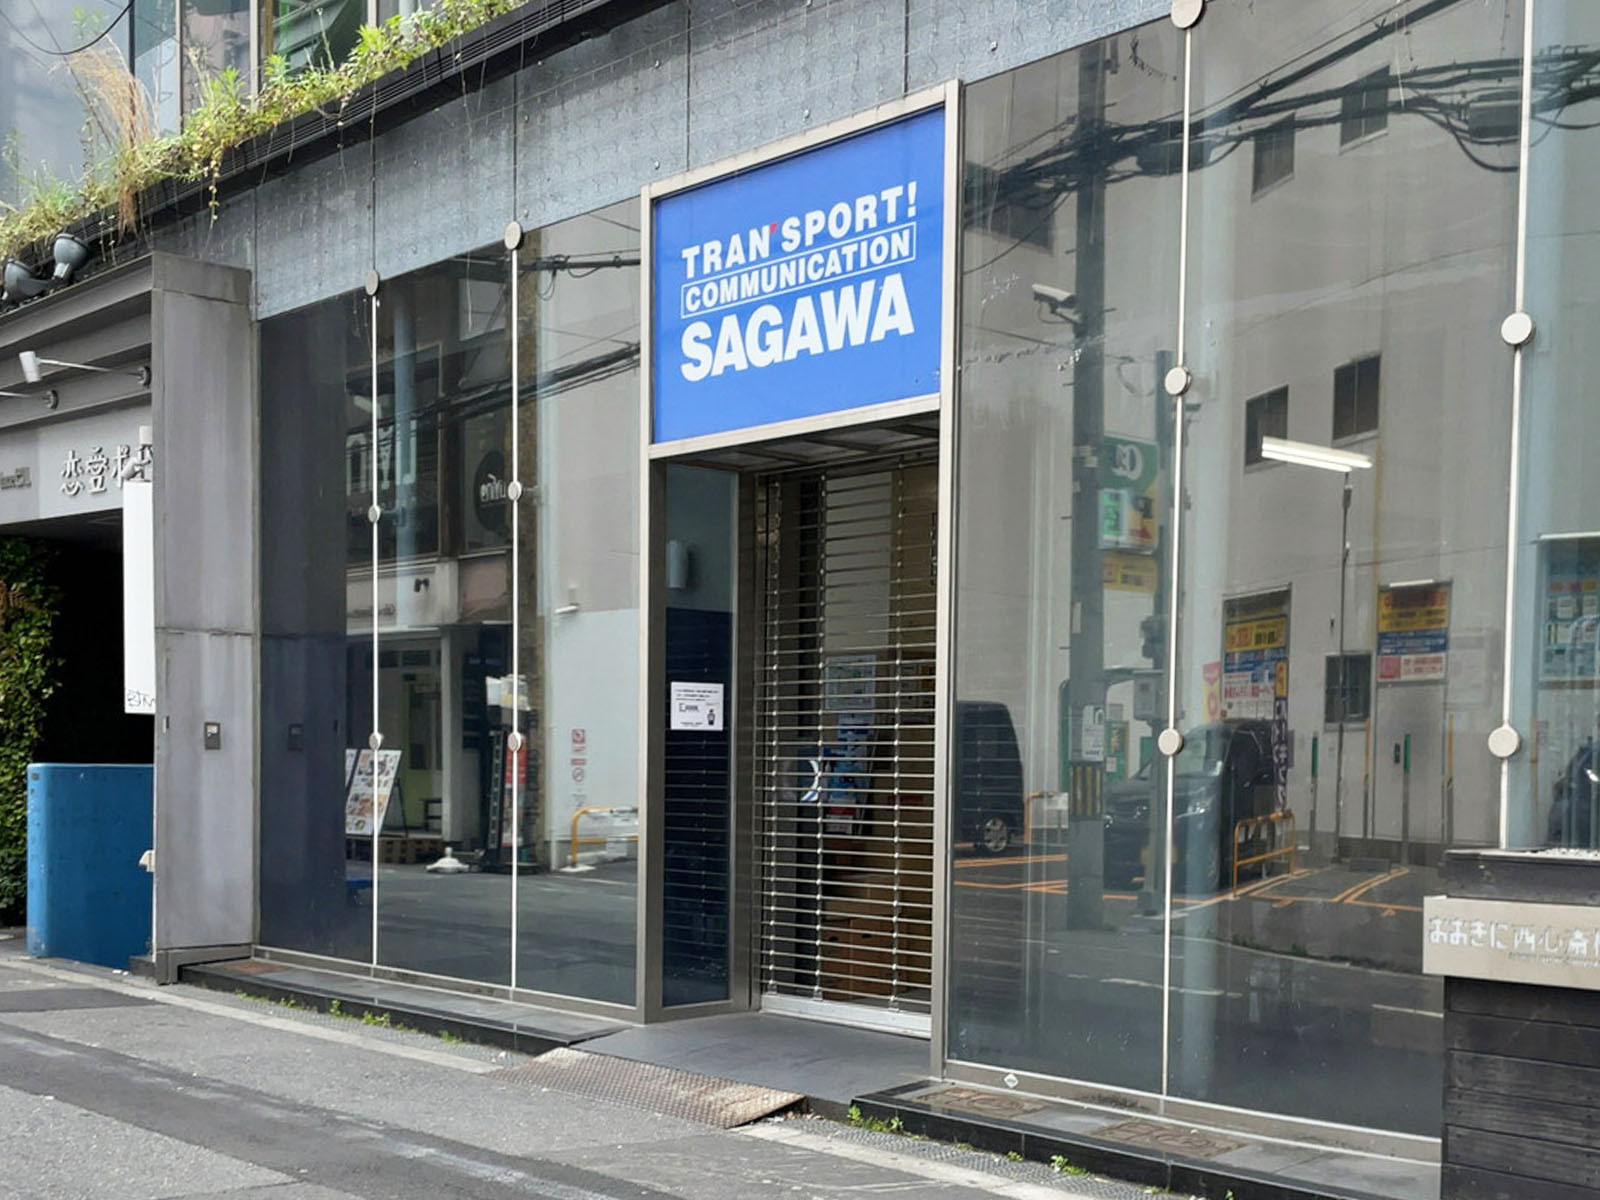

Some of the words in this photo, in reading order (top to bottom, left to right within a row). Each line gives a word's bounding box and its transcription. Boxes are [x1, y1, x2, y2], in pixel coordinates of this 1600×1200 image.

[685, 229, 911, 313] COMMUNICATION
[680, 273, 915, 382] SAGAWA
[1429, 916, 1600, 957] おおきに西心斎
